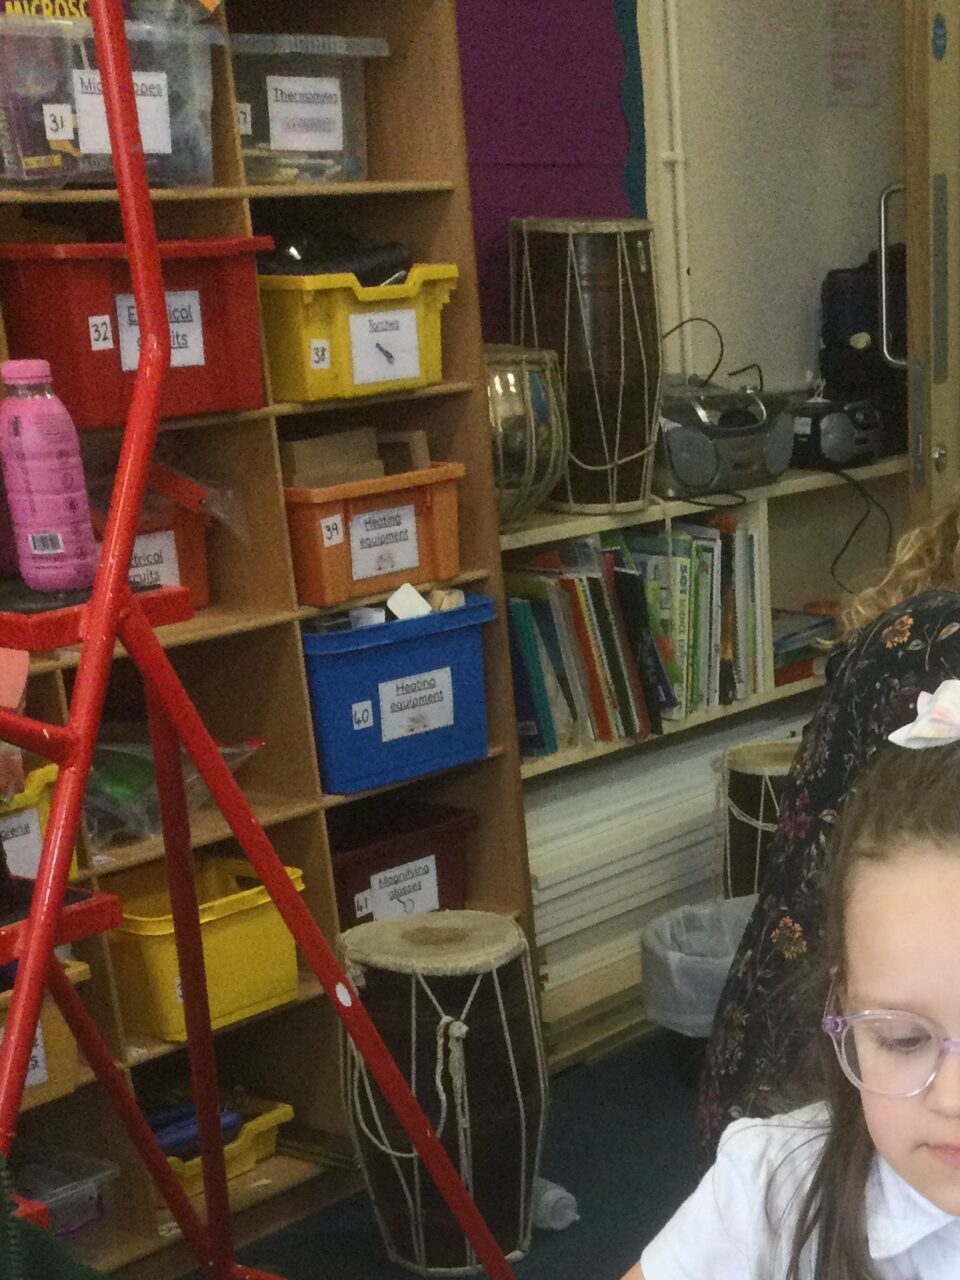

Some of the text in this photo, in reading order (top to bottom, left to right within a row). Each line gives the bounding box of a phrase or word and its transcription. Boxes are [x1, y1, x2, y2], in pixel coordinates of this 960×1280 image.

[49, 113, 64, 133] 31
[91, 321, 109, 342] 32
[367, 319, 400, 333] Torches
[313, 346, 327, 364] 38
[325, 522, 339, 540] 39
[364, 512, 402, 531] Heating
[359, 528, 409, 549] equipment
[395, 677, 437, 696] Heating
[389, 690, 445, 713] equipment
[353, 708, 370, 726] 40
[378, 864, 430, 890] Magnifying
[389, 880, 423, 901] glasses
